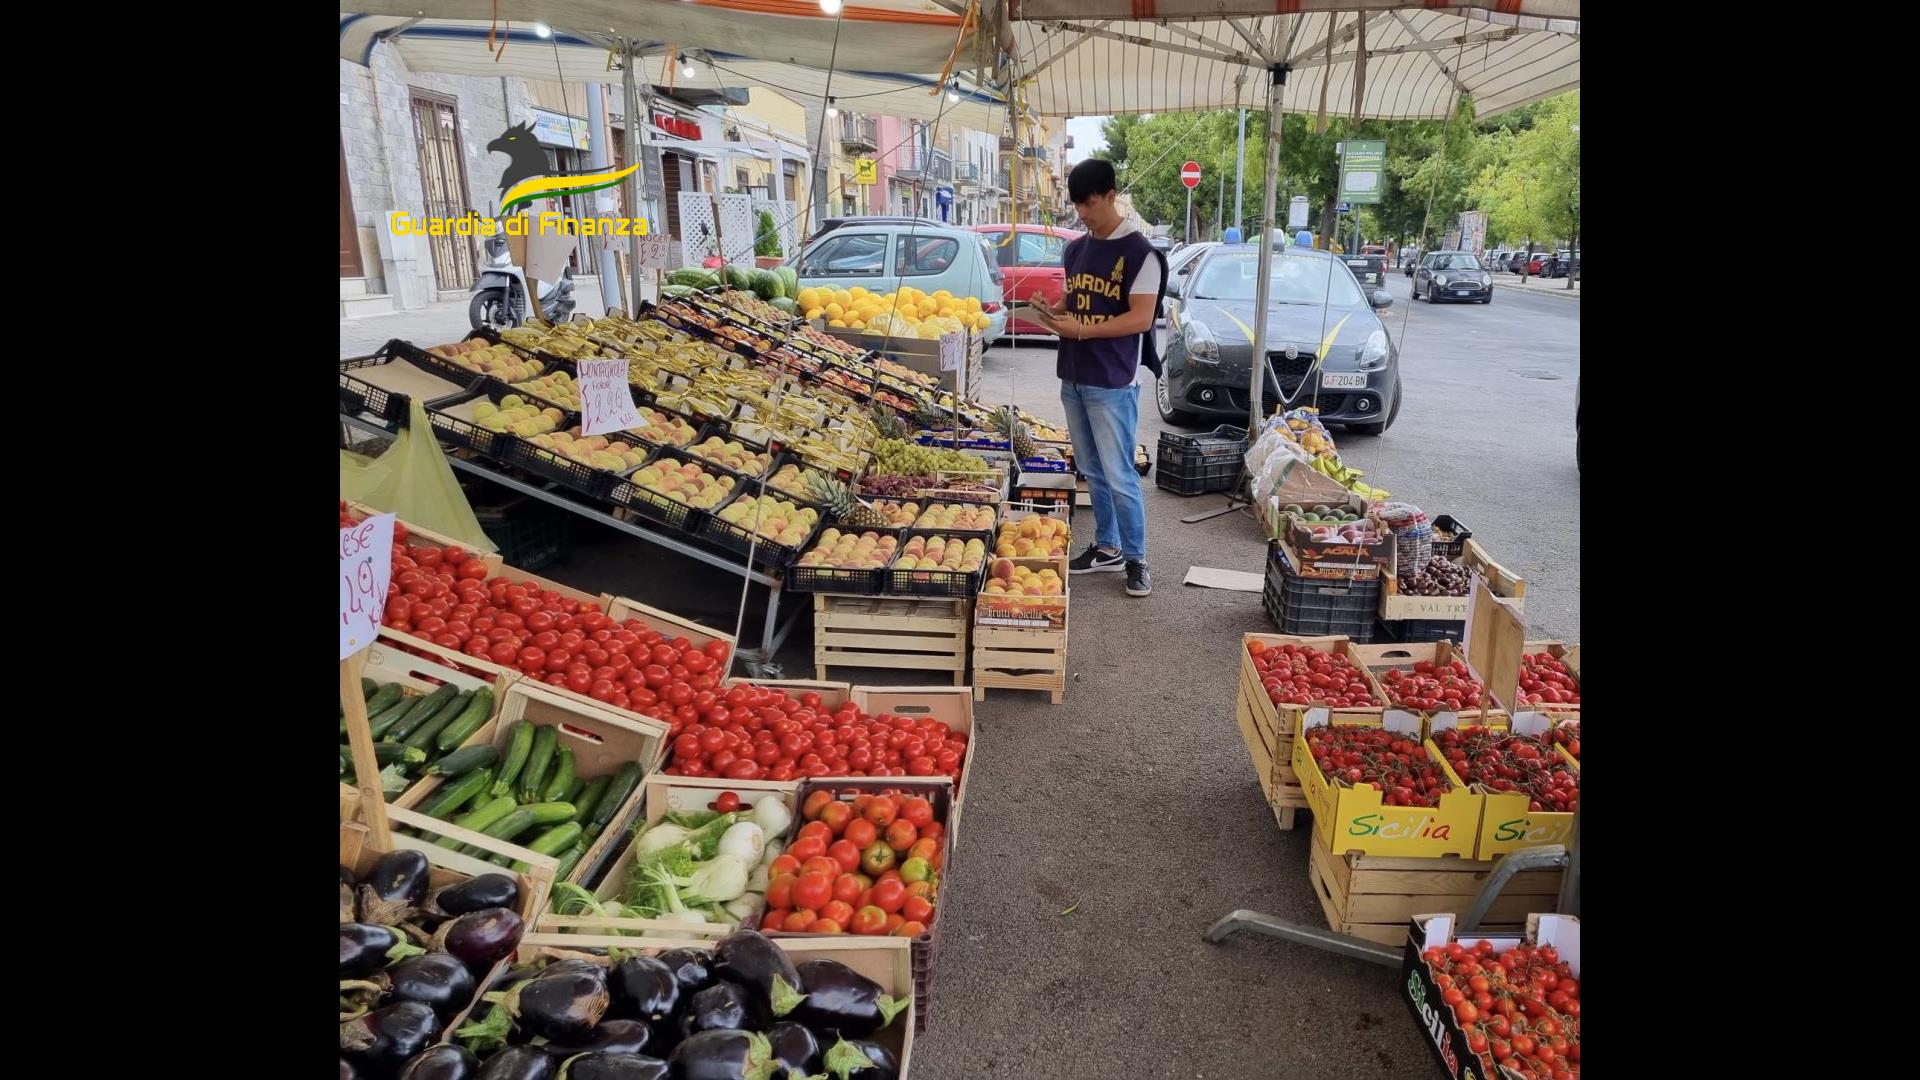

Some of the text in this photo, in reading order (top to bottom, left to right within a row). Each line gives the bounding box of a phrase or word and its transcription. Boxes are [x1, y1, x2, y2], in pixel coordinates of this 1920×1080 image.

[1066, 273, 1121, 300] GUARDIA
[1077, 294, 1091, 310] DI
[579, 361, 626, 378] MONTAGNOLA
[1338, 375, 1354, 386] 204
[1355, 375, 1366, 386] BN
[1019, 608, 1042, 620] Sicilia
[1420, 604, 1440, 613] VAL
[1349, 814, 1451, 841] Sicilia
[1407, 969, 1459, 1080] Sicilia
